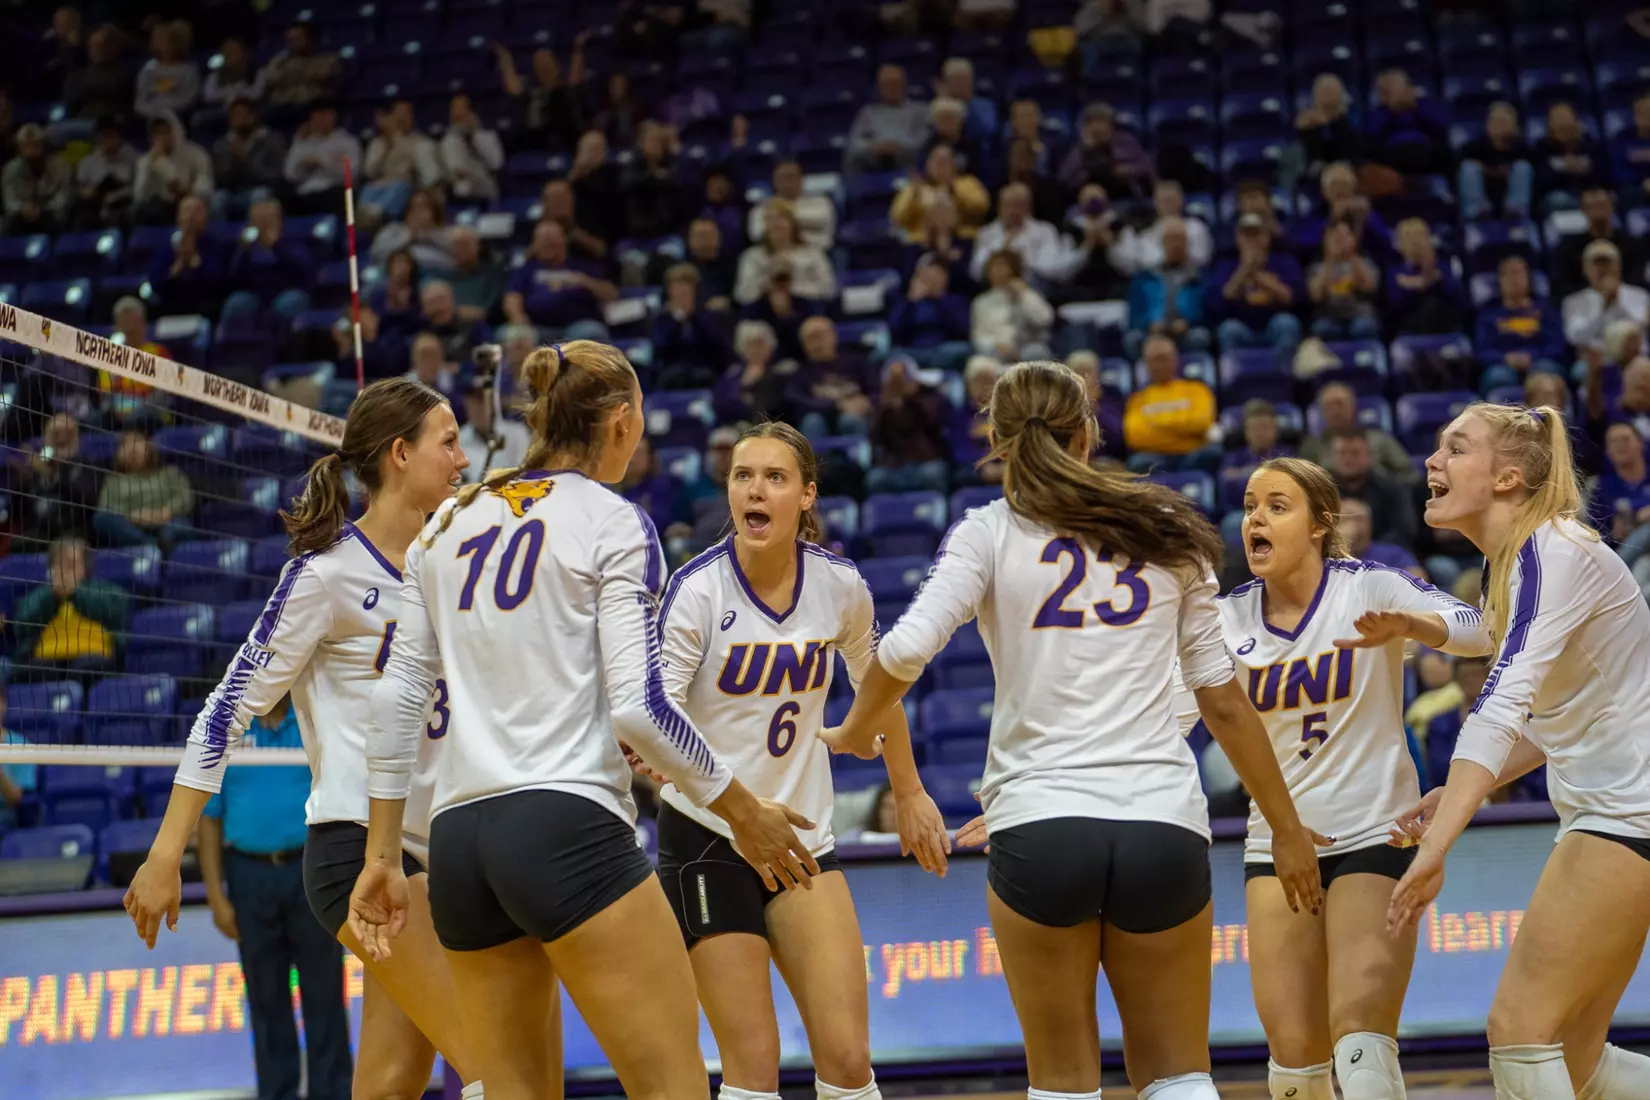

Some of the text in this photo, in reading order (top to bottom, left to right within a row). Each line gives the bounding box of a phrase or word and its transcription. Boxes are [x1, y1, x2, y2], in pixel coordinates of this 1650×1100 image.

[75, 331, 157, 377] NORTHERN IOWA
[203, 374, 247, 407] NORTHERN
[456, 518, 546, 612] 10
[1031, 535, 1152, 630] 23
[716, 639, 832, 698] UNI
[1247, 647, 1357, 713] UNI
[766, 700, 801, 758] 6
[1297, 711, 1330, 762] 5
[880, 939, 969, 999] your
